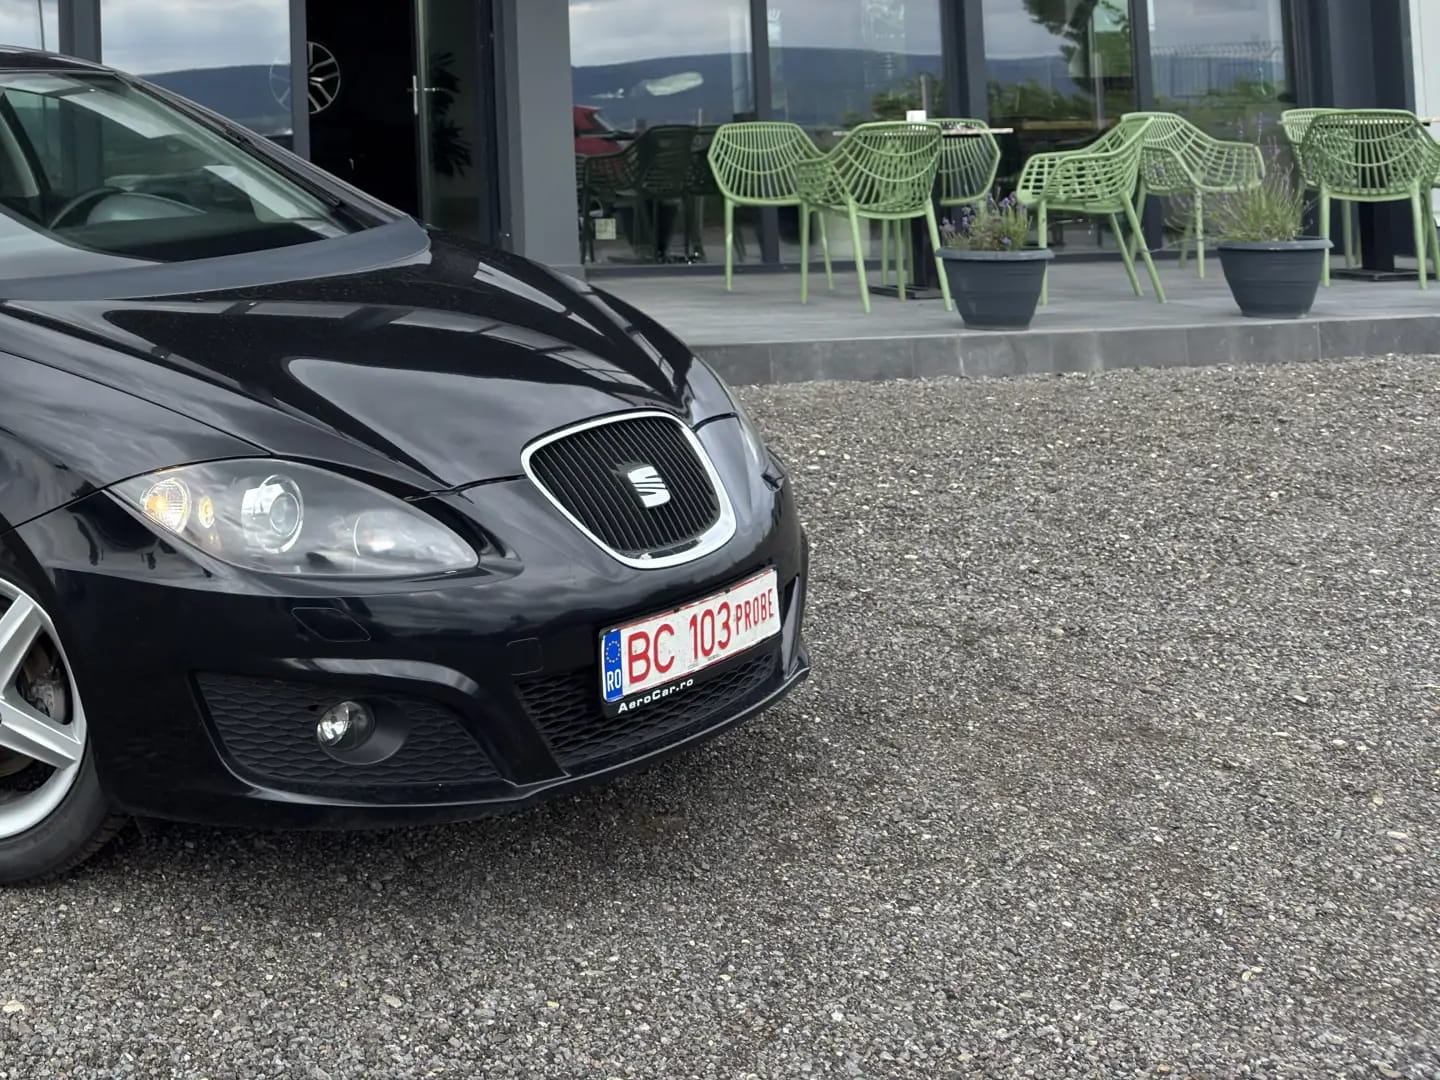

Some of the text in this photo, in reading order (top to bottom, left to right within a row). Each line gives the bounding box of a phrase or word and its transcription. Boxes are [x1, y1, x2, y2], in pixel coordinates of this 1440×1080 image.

[627, 588, 774, 685] BC 103 PROBE
[606, 669, 621, 692] RO
[617, 678, 694, 714] AeroCar.ro
